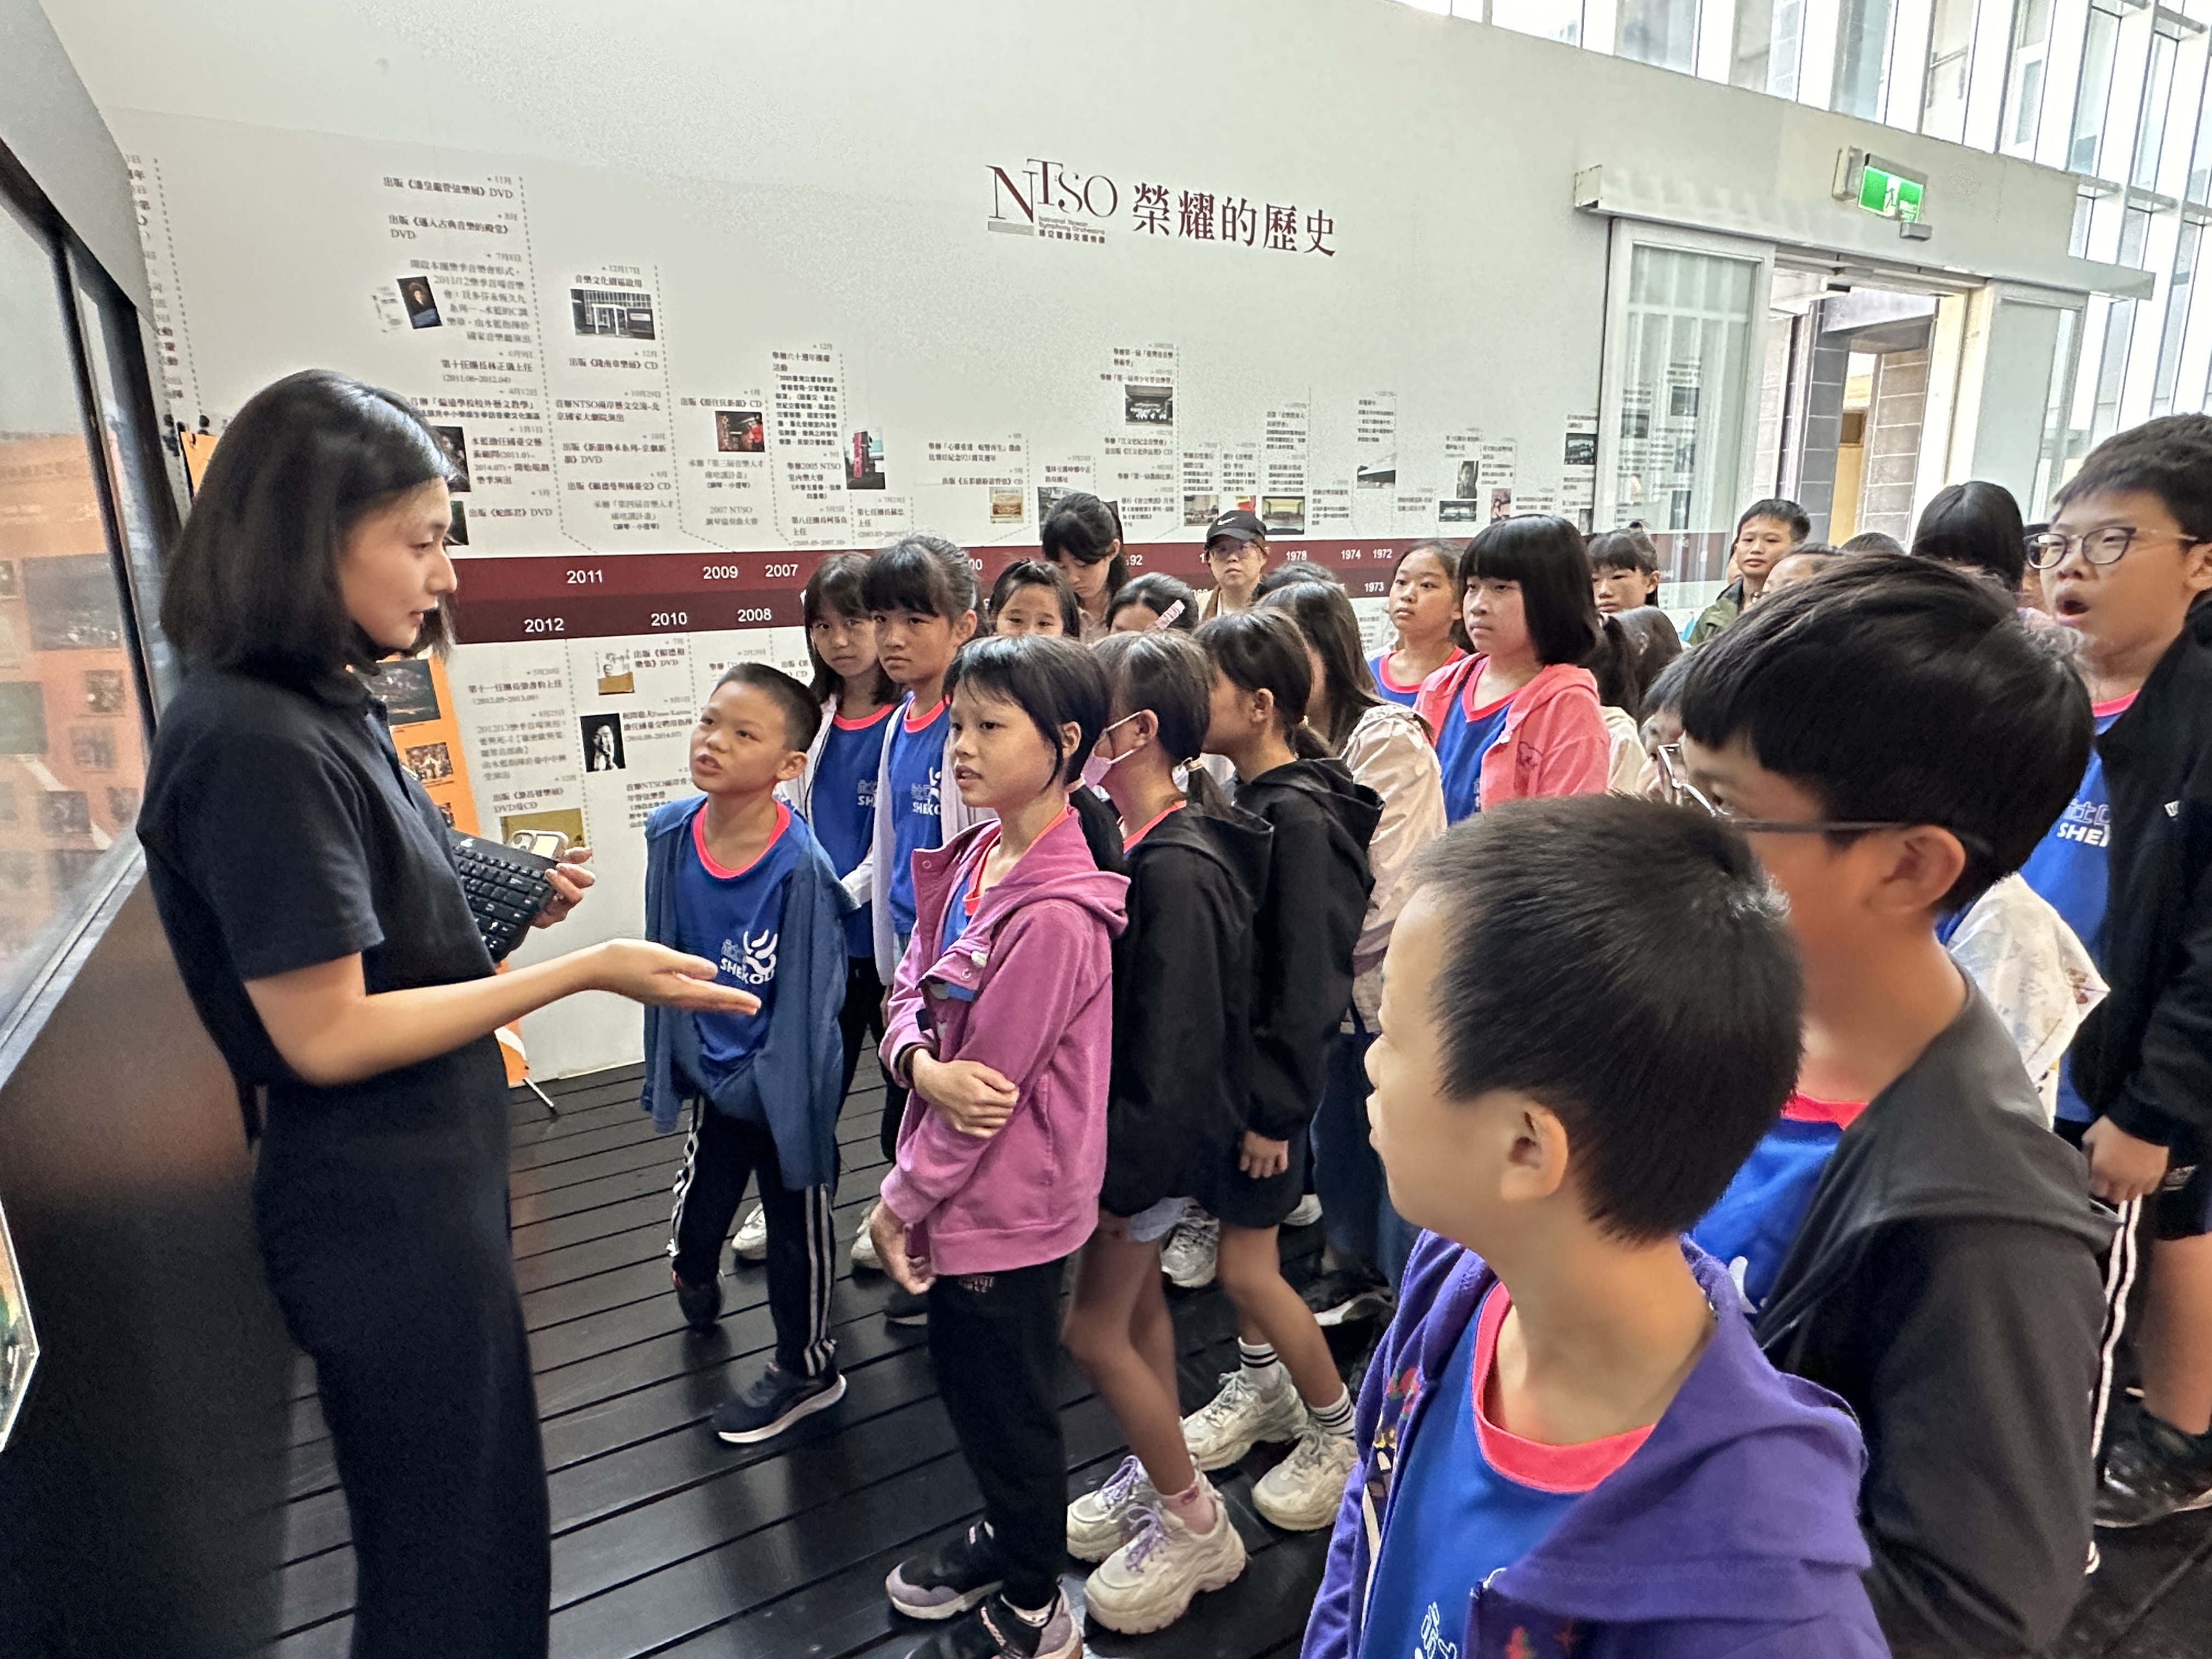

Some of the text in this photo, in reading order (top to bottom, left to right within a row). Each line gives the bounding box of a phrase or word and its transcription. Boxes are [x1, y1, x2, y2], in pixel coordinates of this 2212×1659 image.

[489, 188, 514, 199] DVD
[985, 158, 1118, 223] NTSO
[1133, 182, 1335, 257] 榮耀的歷史
[391, 229, 417, 239] DVD
[644, 361, 659, 370] CD
[581, 455, 603, 464] DVD
[530, 508, 553, 517] DVD
[858, 519, 871, 527] 上任
[1286, 551, 1307, 561] 1978
[1341, 549, 1361, 560] 1974
[1373, 549, 1392, 559] 1972
[703, 566, 738, 579] 2009
[765, 563, 798, 577] 2007
[566, 569, 603, 584] 2011
[1364, 582, 1384, 592] 1973
[651, 612, 687, 627] 2010
[737, 607, 772, 622] 2008
[524, 617, 565, 633] 2012
